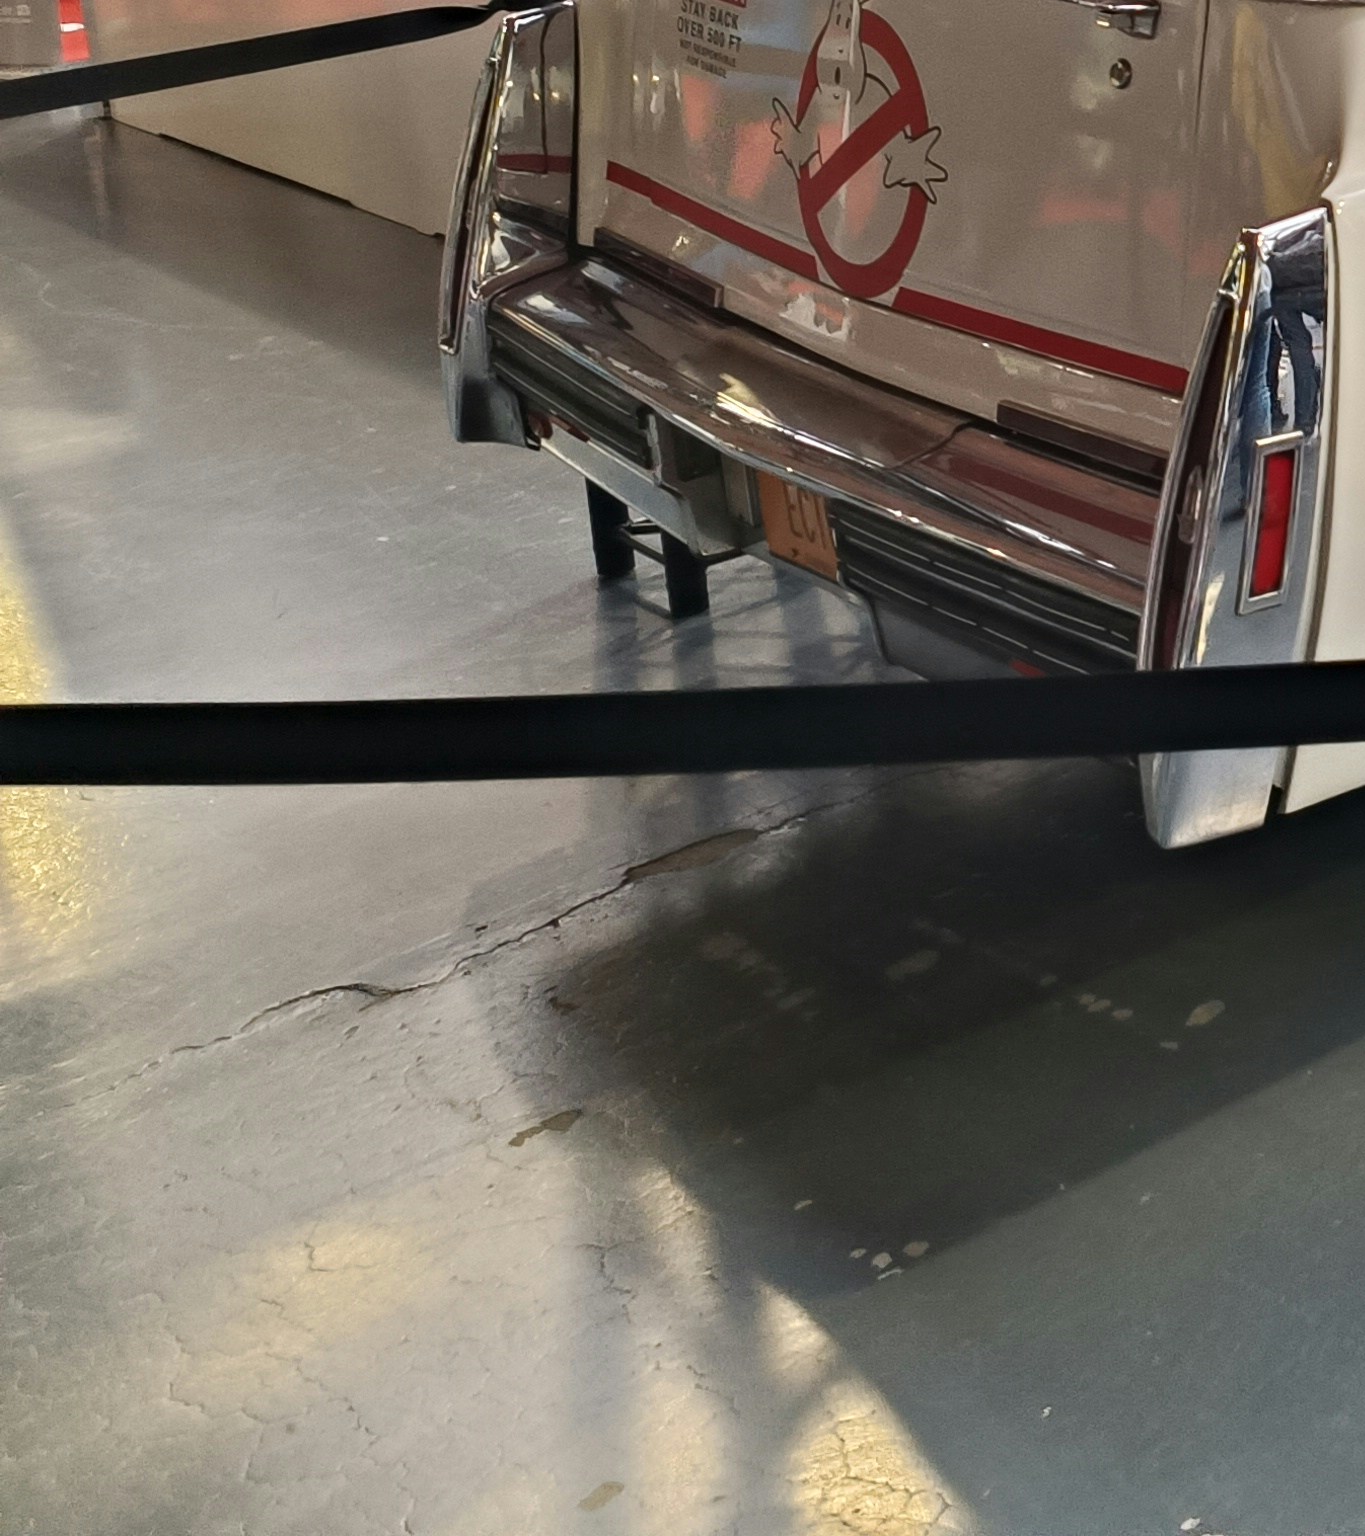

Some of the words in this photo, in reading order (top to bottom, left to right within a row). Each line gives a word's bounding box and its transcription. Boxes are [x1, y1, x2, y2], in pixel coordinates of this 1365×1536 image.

[708, 5, 739, 30] BACK
[677, 15, 704, 40] OVER
[707, 26, 725, 48] 500
[728, 34, 742, 52] FT
